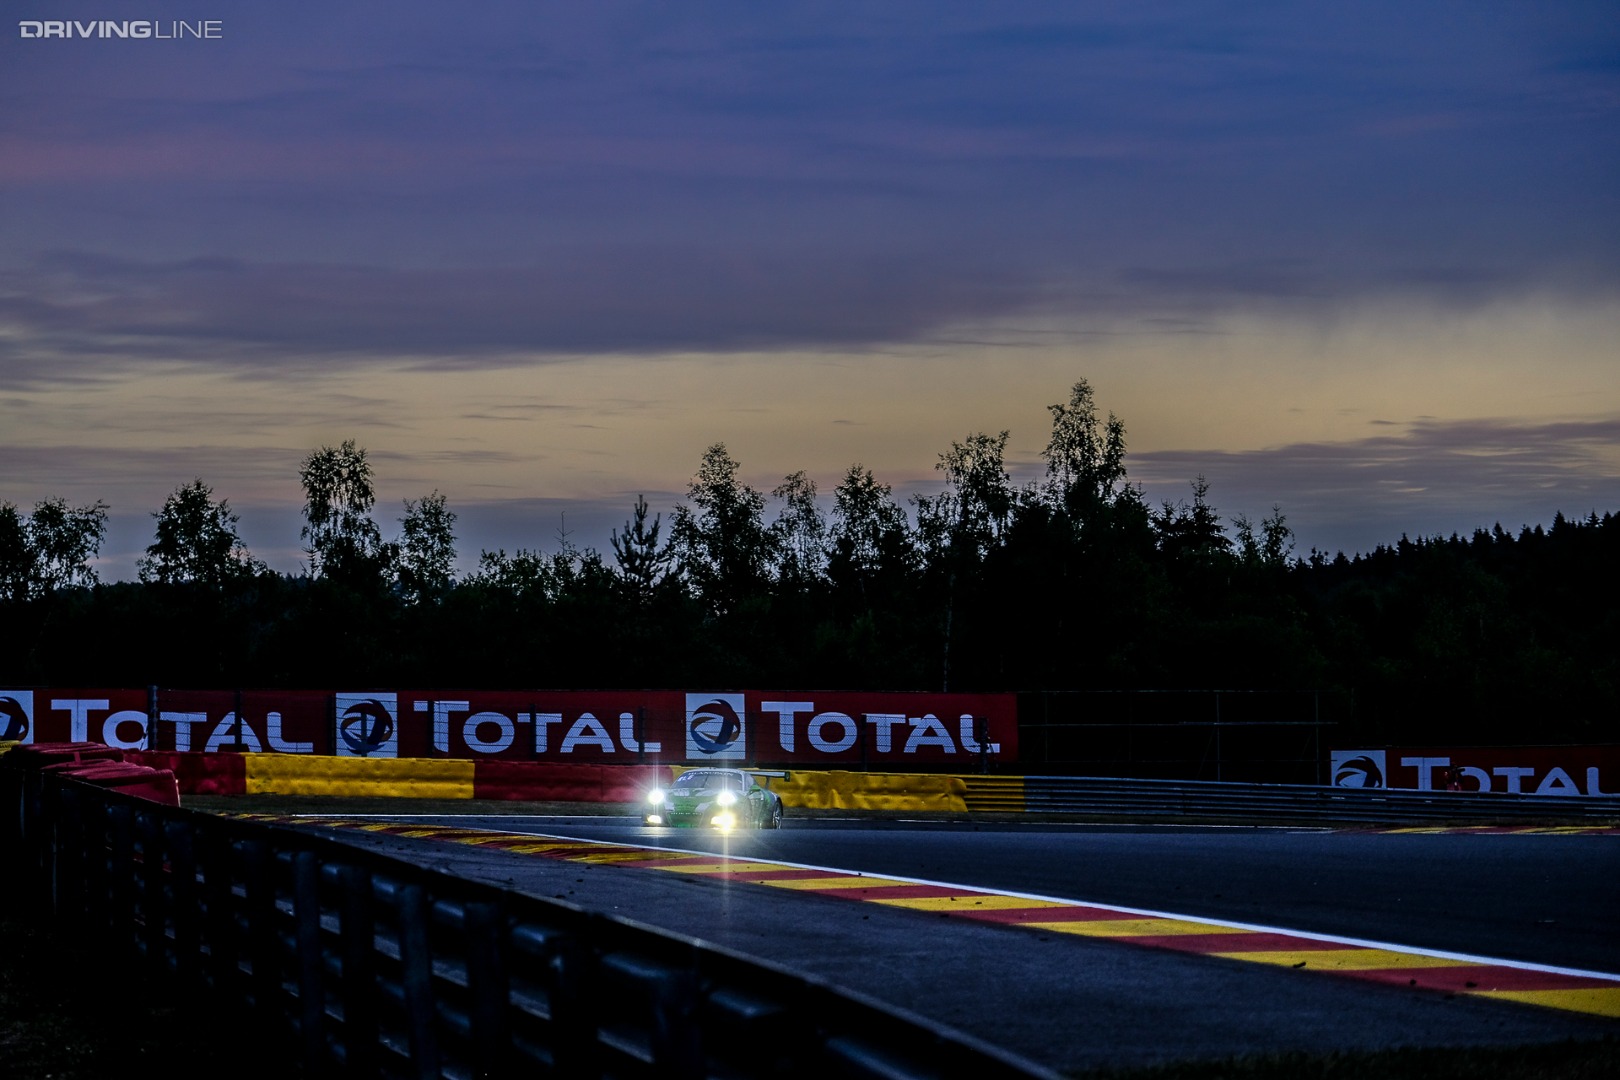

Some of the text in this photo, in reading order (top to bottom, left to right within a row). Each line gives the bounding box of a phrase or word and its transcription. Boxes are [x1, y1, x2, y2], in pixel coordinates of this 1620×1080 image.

[51, 699, 314, 752] TOTAL
[413, 701, 661, 753] TOTAL
[761, 701, 1000, 753] TOTAL
